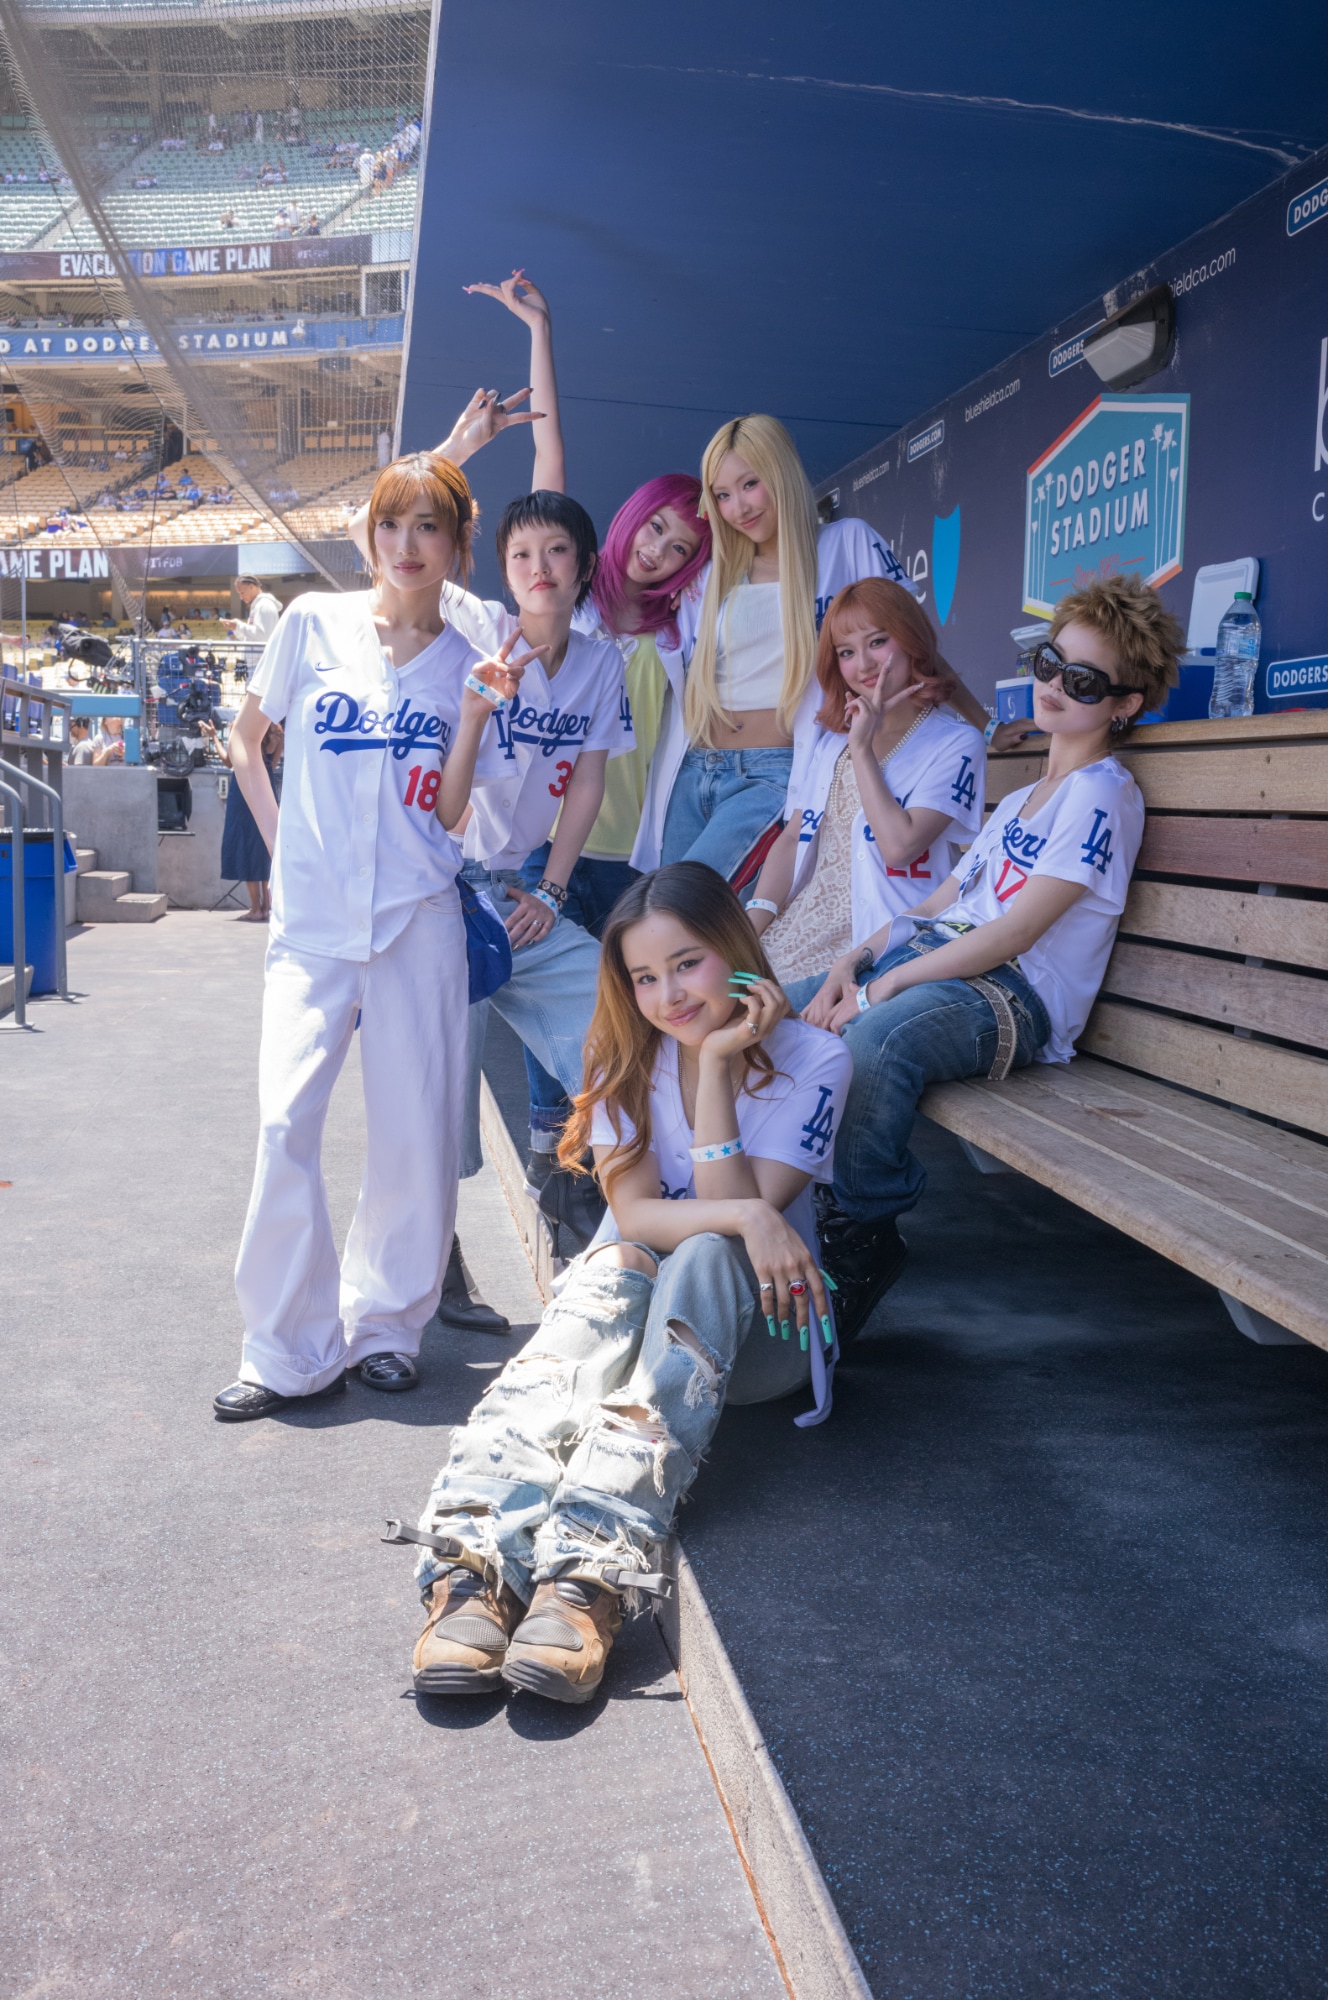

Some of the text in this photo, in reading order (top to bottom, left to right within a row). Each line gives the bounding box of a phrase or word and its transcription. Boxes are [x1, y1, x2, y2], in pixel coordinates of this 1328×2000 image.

[172, 250, 220, 273] GAME
[226, 246, 271, 271] PLAN
[24, 338, 51, 353] AT
[65, 336, 166, 352] DODGE
[178, 331, 288, 349] STADIUM
[965, 379, 1020, 422] blueshieldca.com
[910, 427, 942, 456] DODGERS.COM
[1056, 439, 1146, 508] DODGER
[1051, 488, 1149, 556] STADIUM
[50, 550, 109, 578] PLAN
[509, 693, 591, 758] odger
[404, 765, 442, 812] 18
[951, 755, 976, 812] LA
[1081, 808, 1114, 875] LA
[801, 1085, 834, 1157] LA
